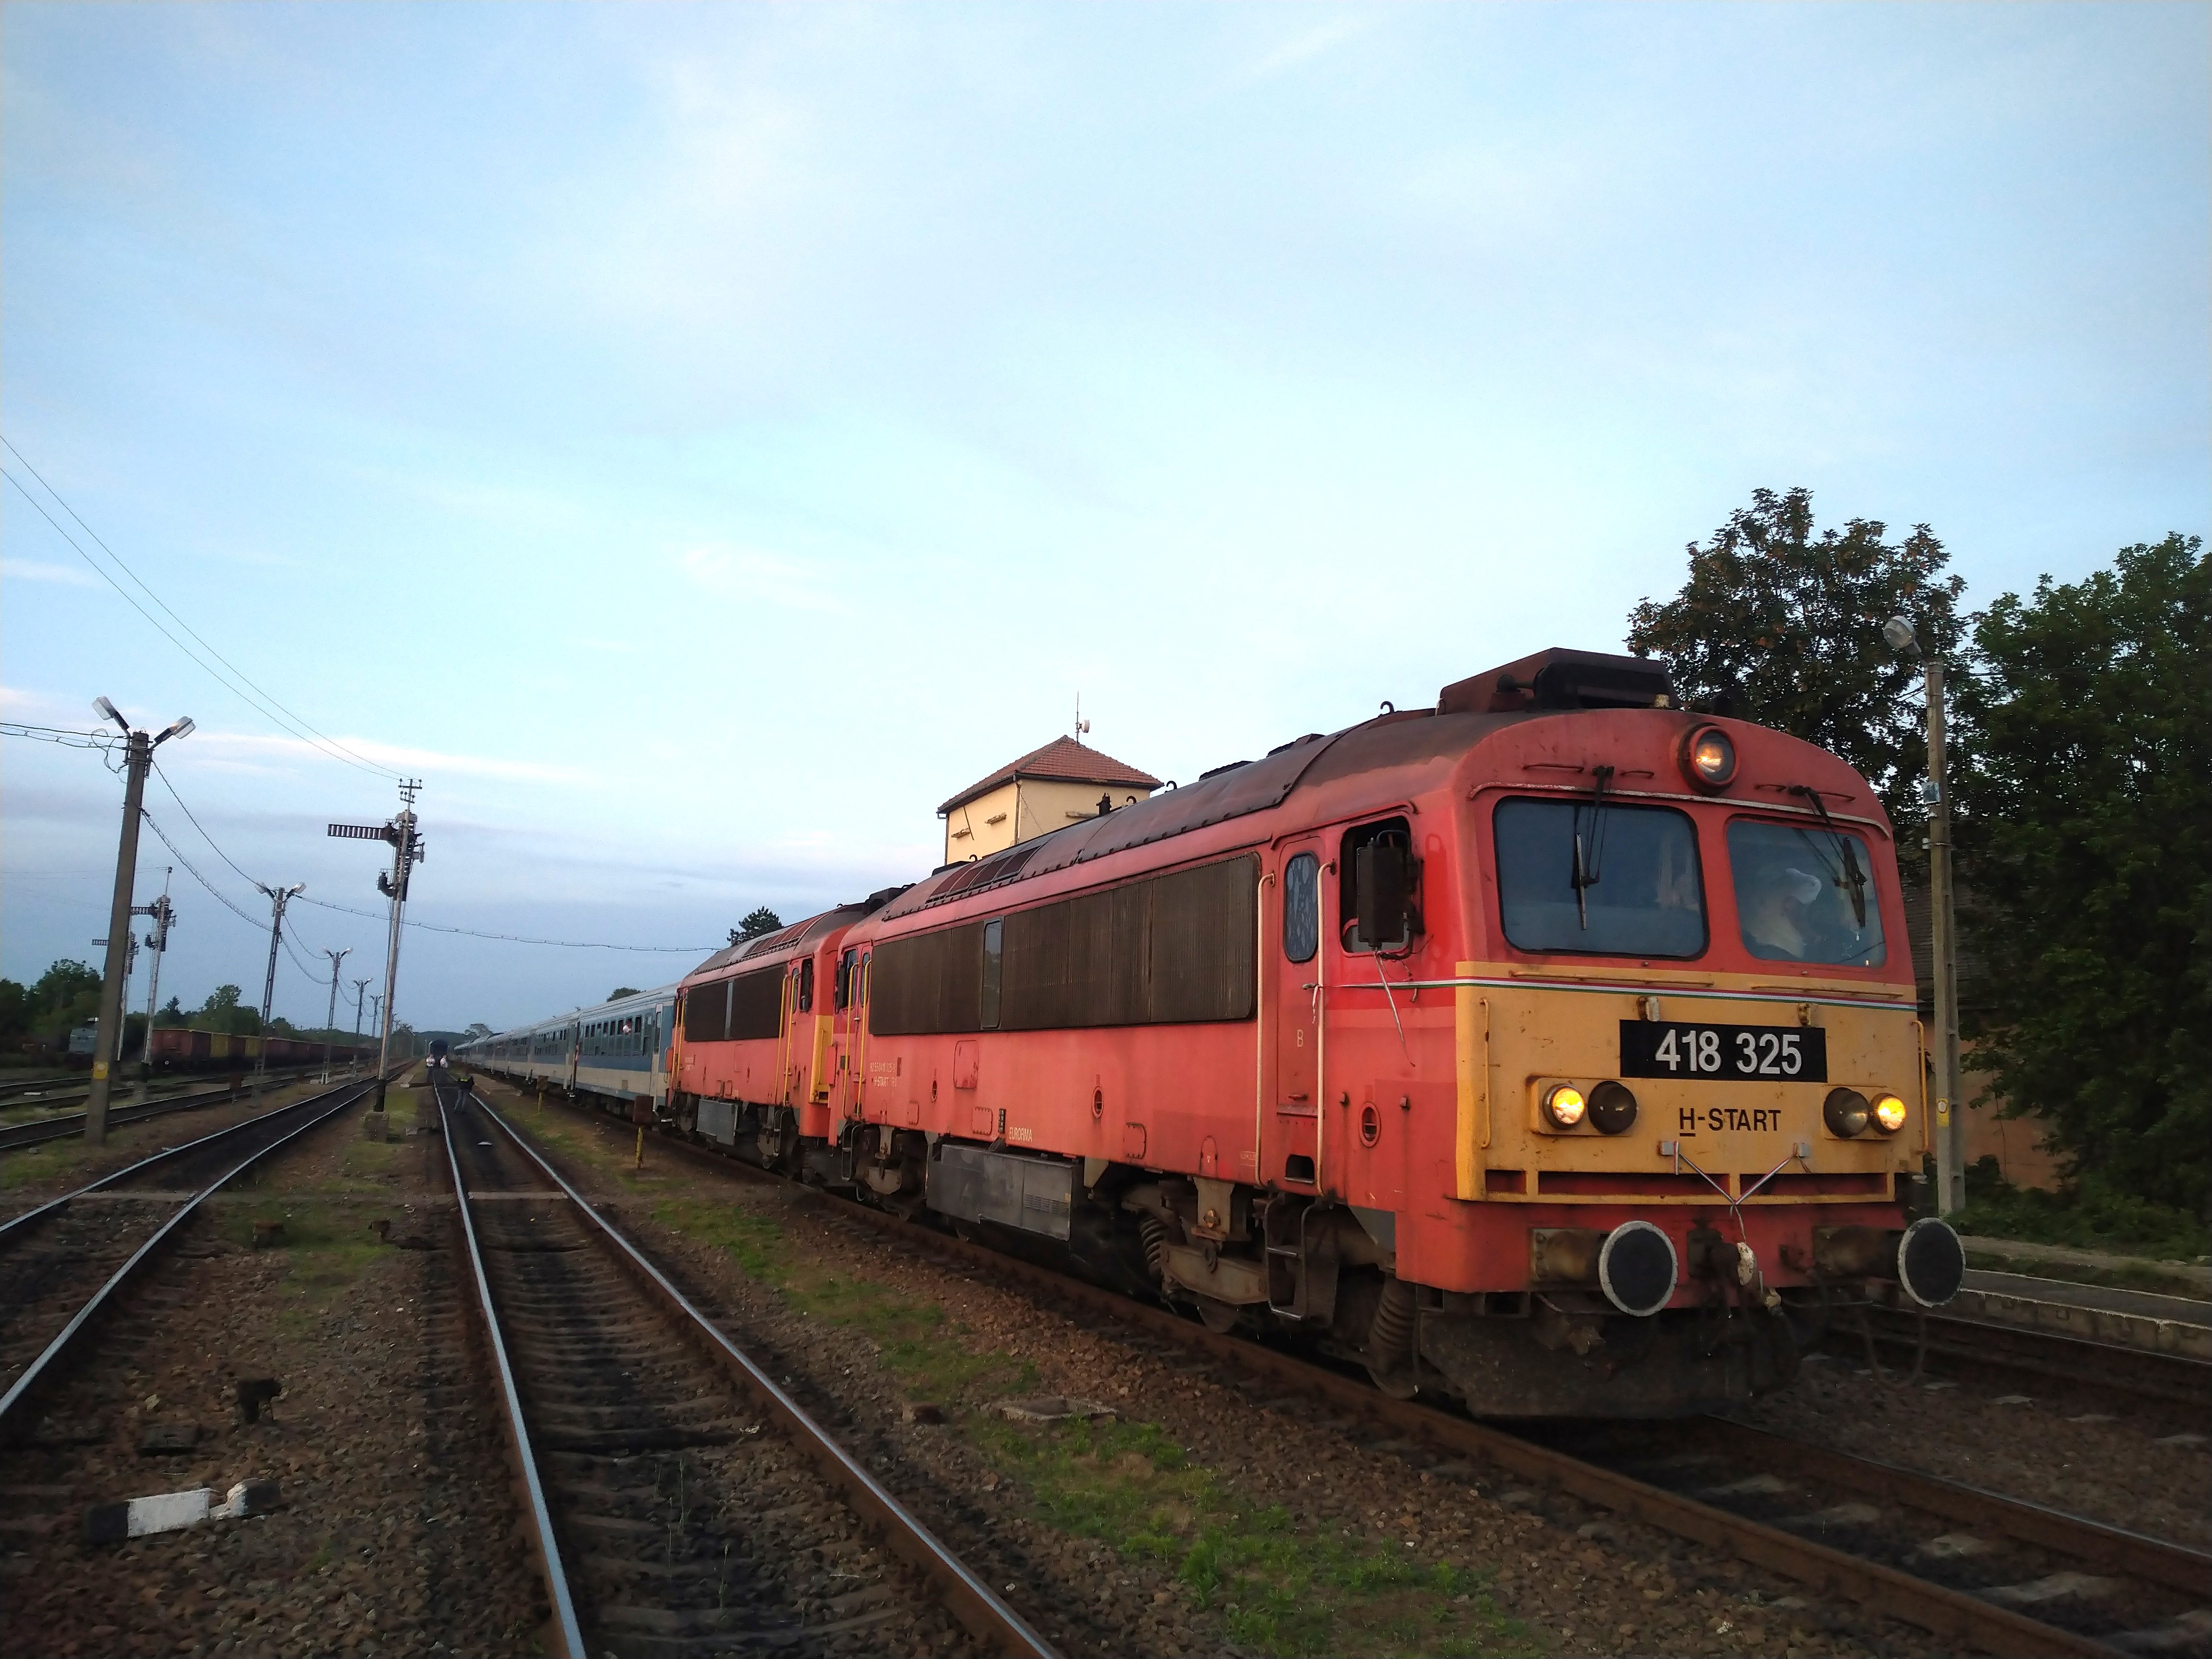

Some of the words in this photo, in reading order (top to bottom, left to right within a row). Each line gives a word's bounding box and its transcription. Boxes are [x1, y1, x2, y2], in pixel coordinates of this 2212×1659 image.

[1297, 1029, 1303, 1048] B
[1655, 1029, 1721, 1072] 418
[1736, 1032, 1802, 1075] 325
[1679, 1107, 1781, 1134] H-START
[1009, 1127, 1033, 1142] EUROFIMA
